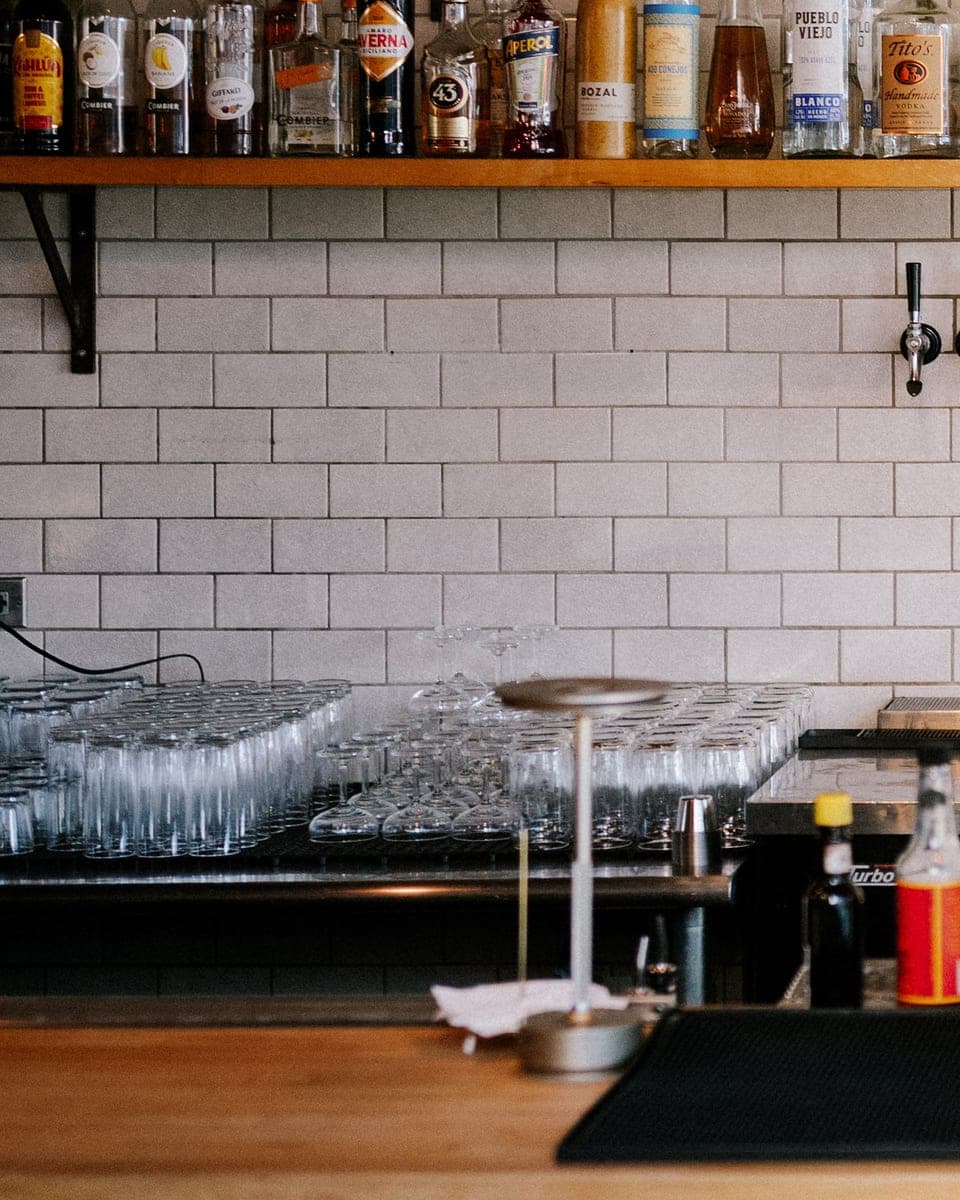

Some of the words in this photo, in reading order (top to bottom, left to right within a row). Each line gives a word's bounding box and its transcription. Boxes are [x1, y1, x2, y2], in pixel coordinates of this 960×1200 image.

[795, 11, 839, 25] PUEBLO
[799, 26, 833, 39] VIEJO
[507, 35, 554, 56] APEROL
[888, 39, 933, 57] Tito's
[432, 83, 458, 102] 43
[581, 87, 618, 97] BOZAL
[885, 88, 940, 101] Handmade
[81, 101, 113, 110] COMBIER
[147, 102, 180, 111] COMBIER
[795, 97, 840, 107] BLANCO
[849, 865, 895, 883] Turbo
